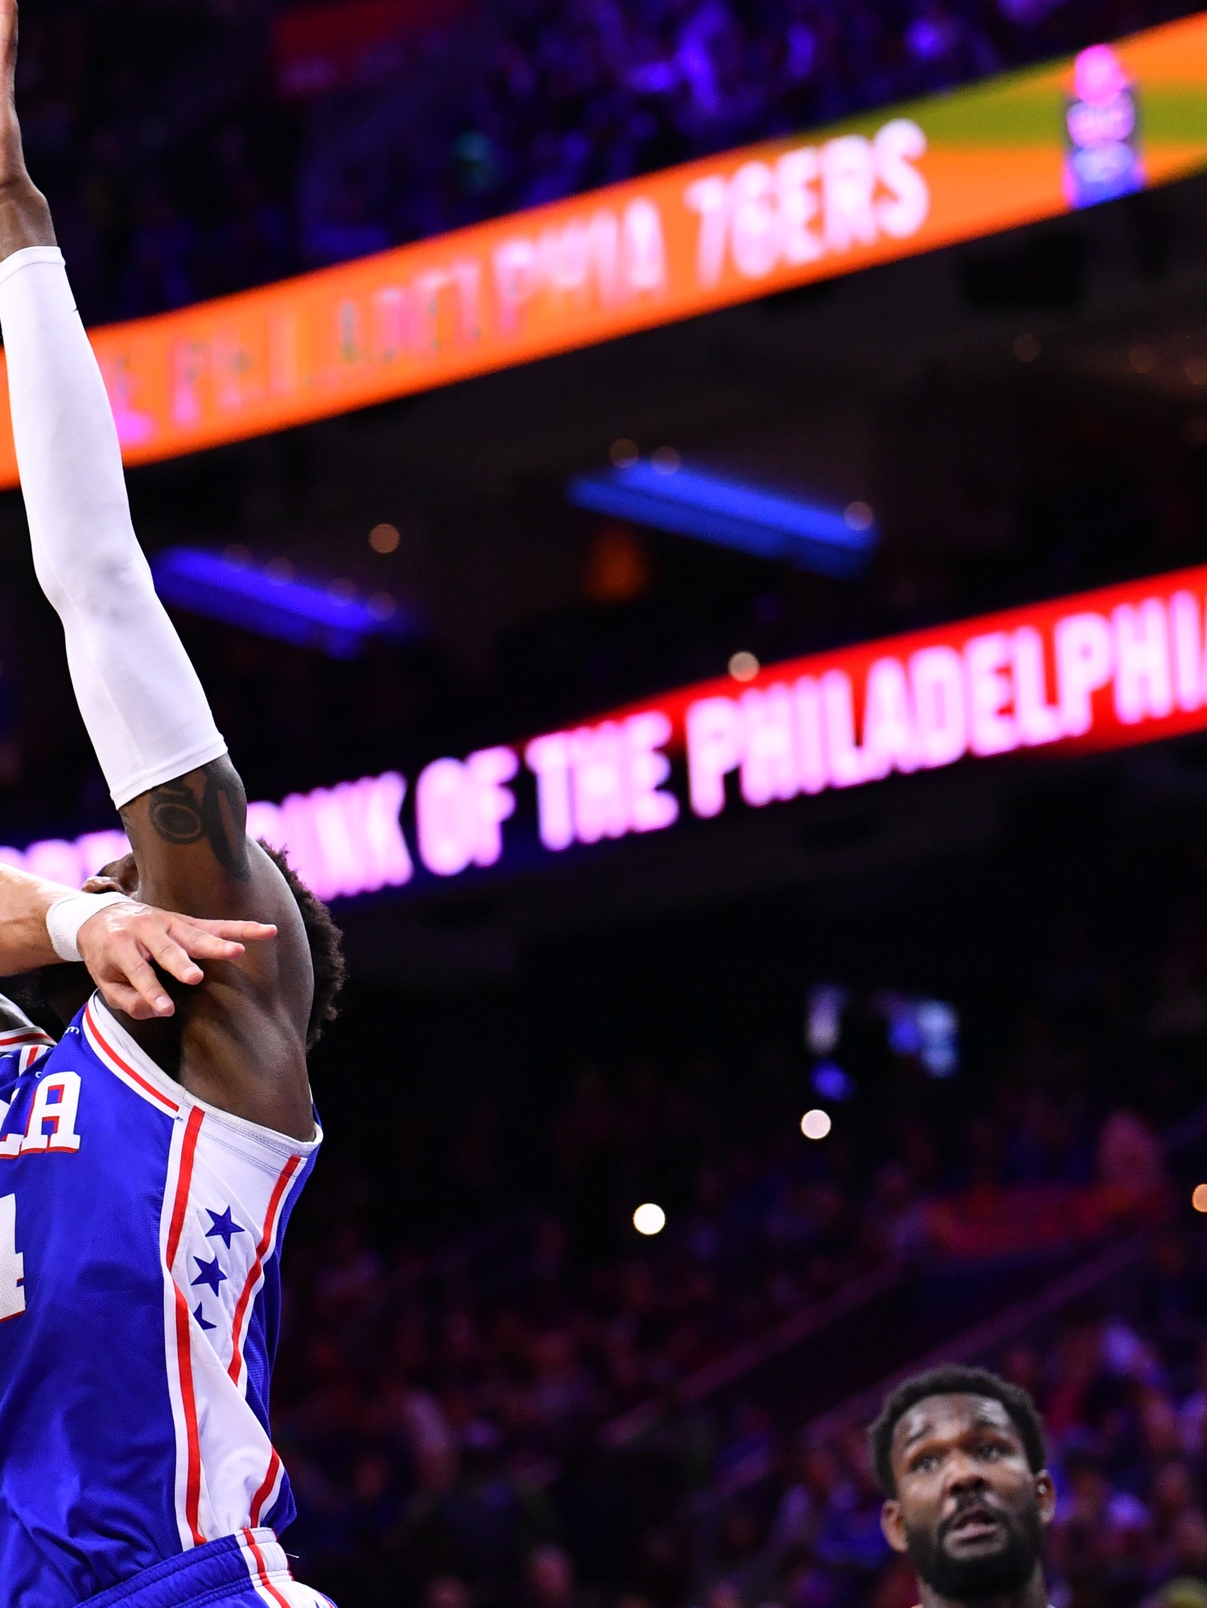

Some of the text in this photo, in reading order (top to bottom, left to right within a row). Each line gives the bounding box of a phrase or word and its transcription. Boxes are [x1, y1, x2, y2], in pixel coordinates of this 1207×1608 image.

[684, 117, 929, 292] 76ERS
[416, 746, 520, 876] OF
[525, 710, 678, 852] THE
[685, 590, 1207, 818] PHILADELPHI
